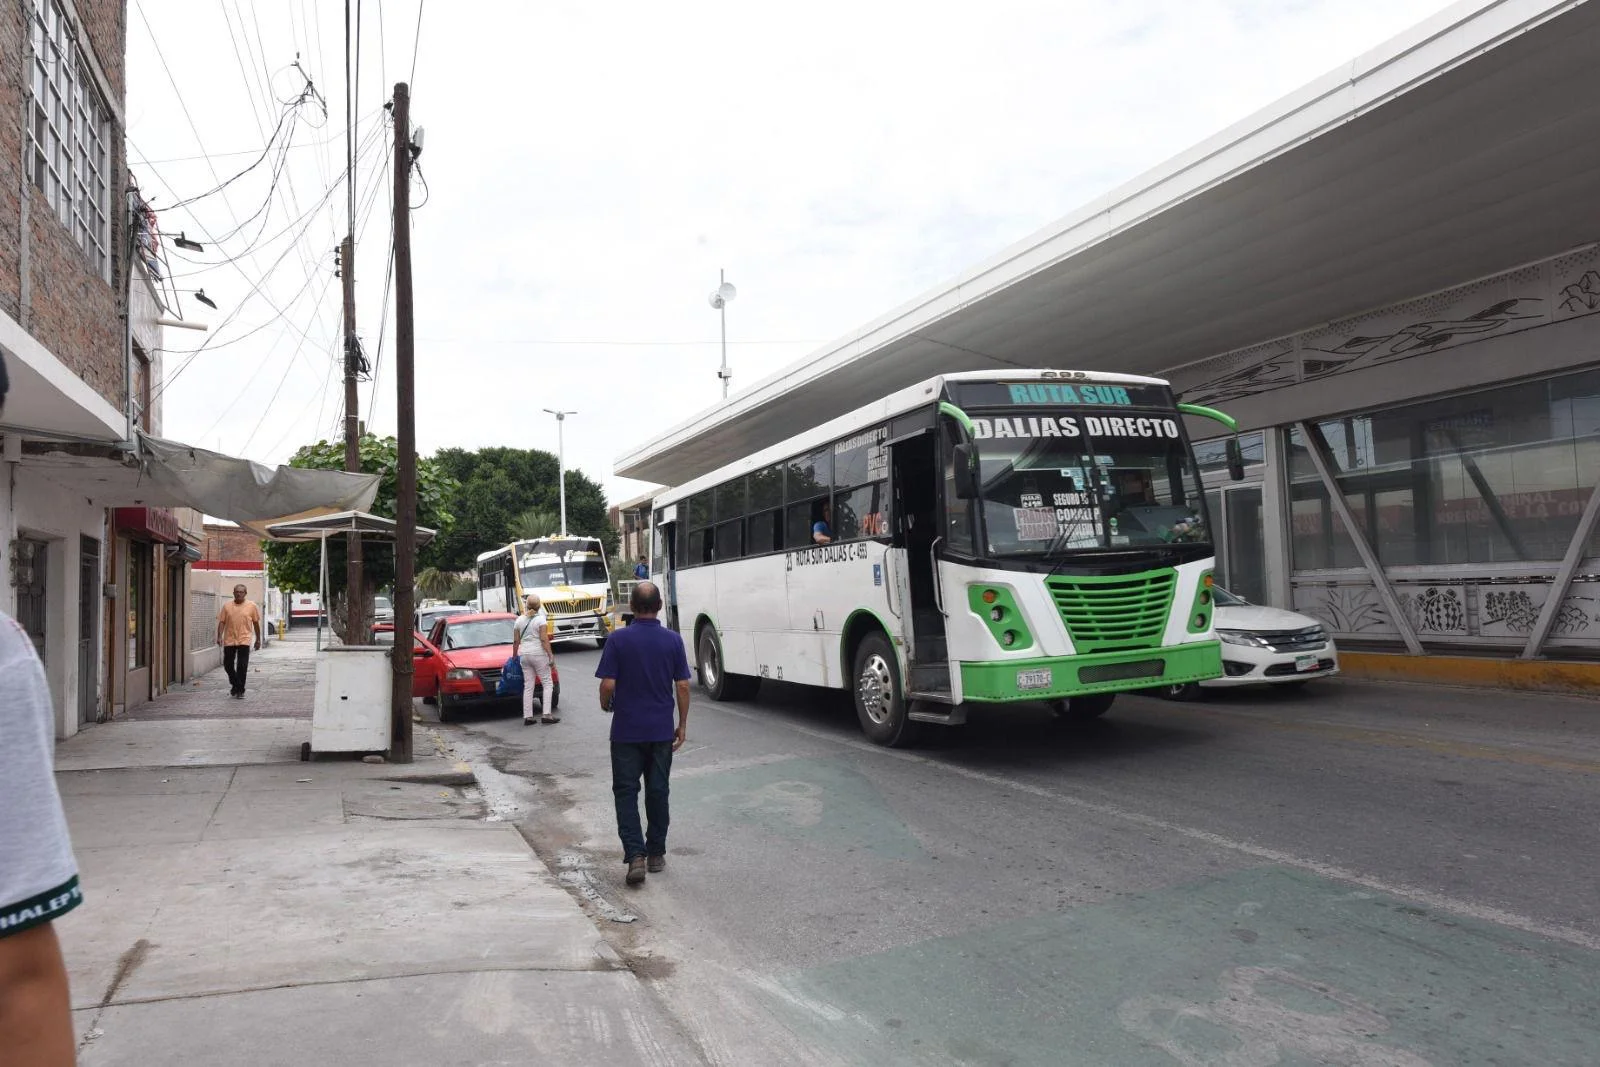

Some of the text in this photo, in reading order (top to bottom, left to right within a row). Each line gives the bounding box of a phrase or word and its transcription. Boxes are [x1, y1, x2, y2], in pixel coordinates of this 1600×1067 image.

[1008, 384, 1131, 406] RUTA SUR
[973, 416, 1179, 440] DALIAS DIRECTO
[796, 549, 811, 566] RUTA
[811, 548, 824, 565] SUR
[824, 545, 847, 564] DALIAS
